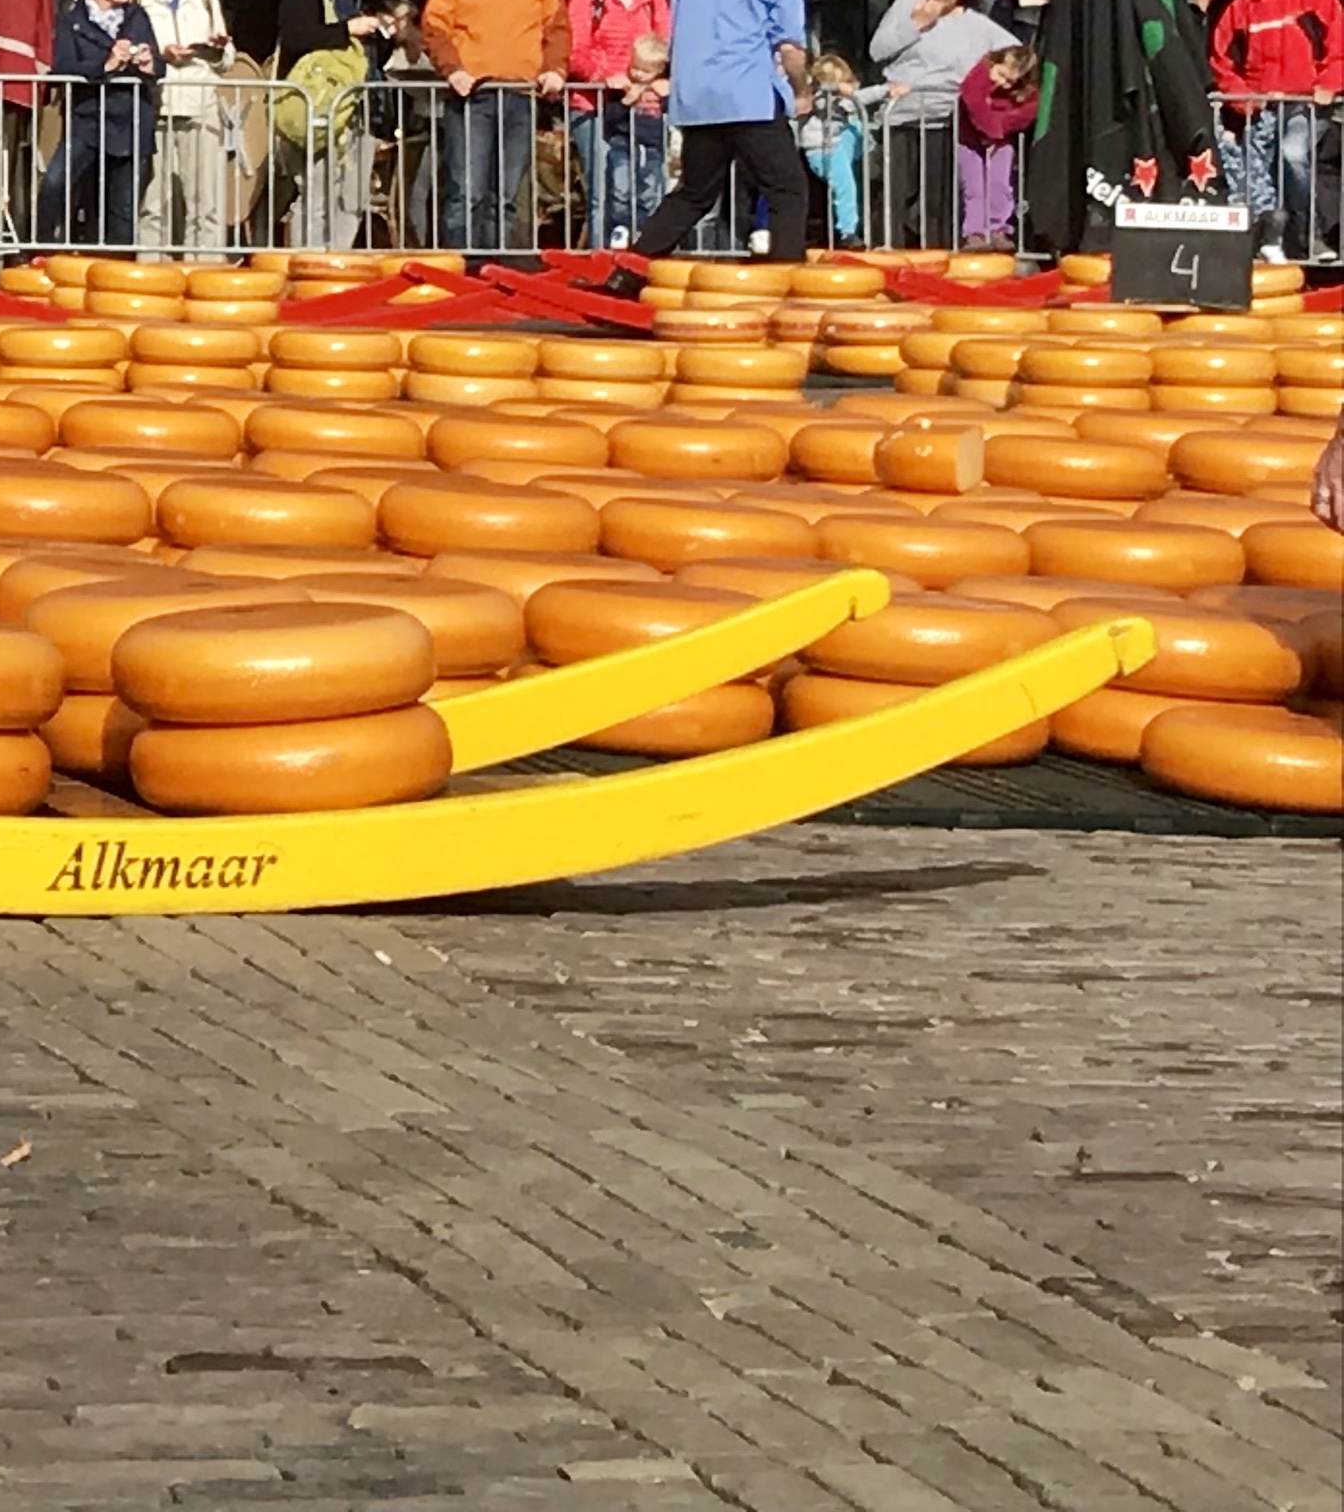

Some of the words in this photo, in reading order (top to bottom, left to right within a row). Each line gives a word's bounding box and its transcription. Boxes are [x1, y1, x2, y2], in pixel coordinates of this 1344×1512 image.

[1144, 209, 1220, 224] ALKMAAR
[1171, 244, 1199, 290] 4
[45, 840, 279, 892] Alkmaar
